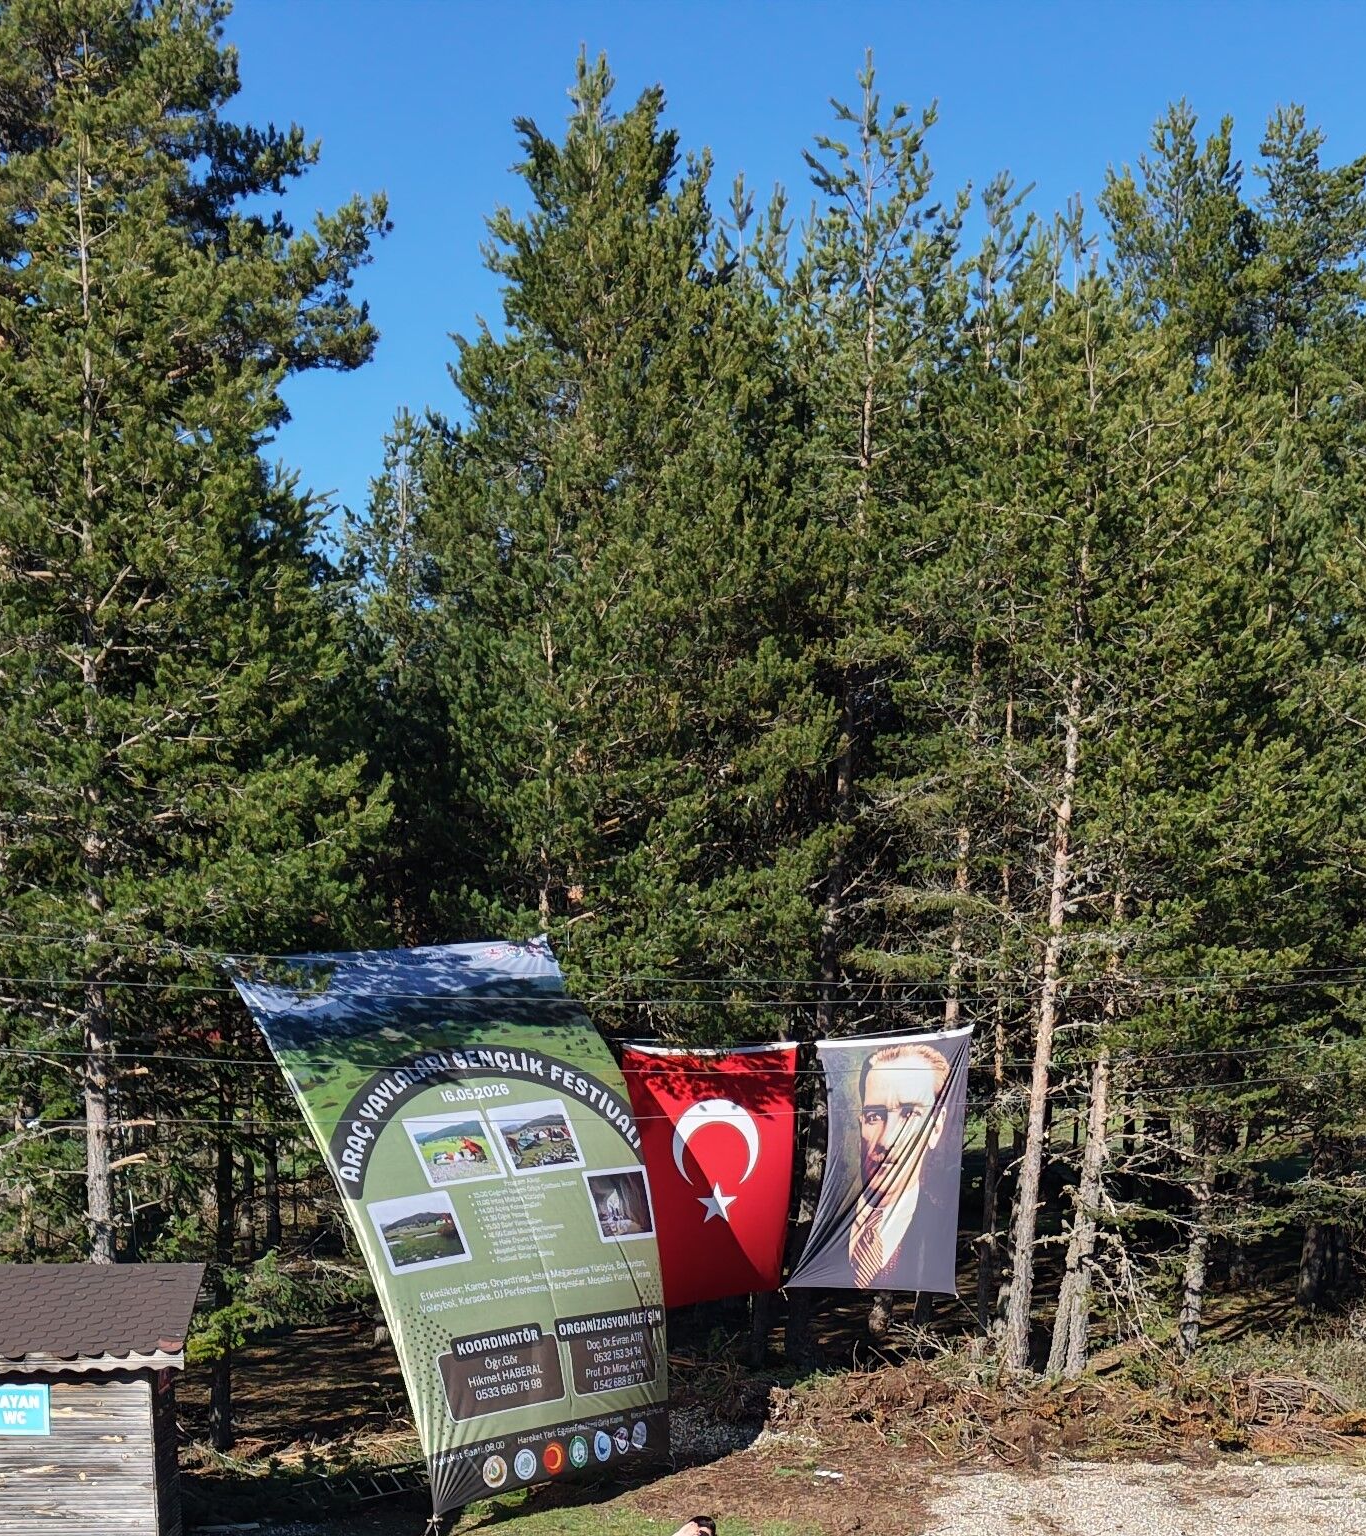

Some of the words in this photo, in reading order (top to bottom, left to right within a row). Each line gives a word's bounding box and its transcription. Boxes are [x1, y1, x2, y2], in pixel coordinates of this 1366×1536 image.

[440, 1083, 510, 1102] 16.05.2026
[339, 1121, 375, 1183] ARAÇ
[359, 1054, 450, 1120] YAYLALARI
[452, 1050, 544, 1077] GENÇLİK
[468, 1370, 502, 1388] Hikmet
[502, 1364, 543, 1383] HABERAL
[2, 1410, 27, 1425] WC
